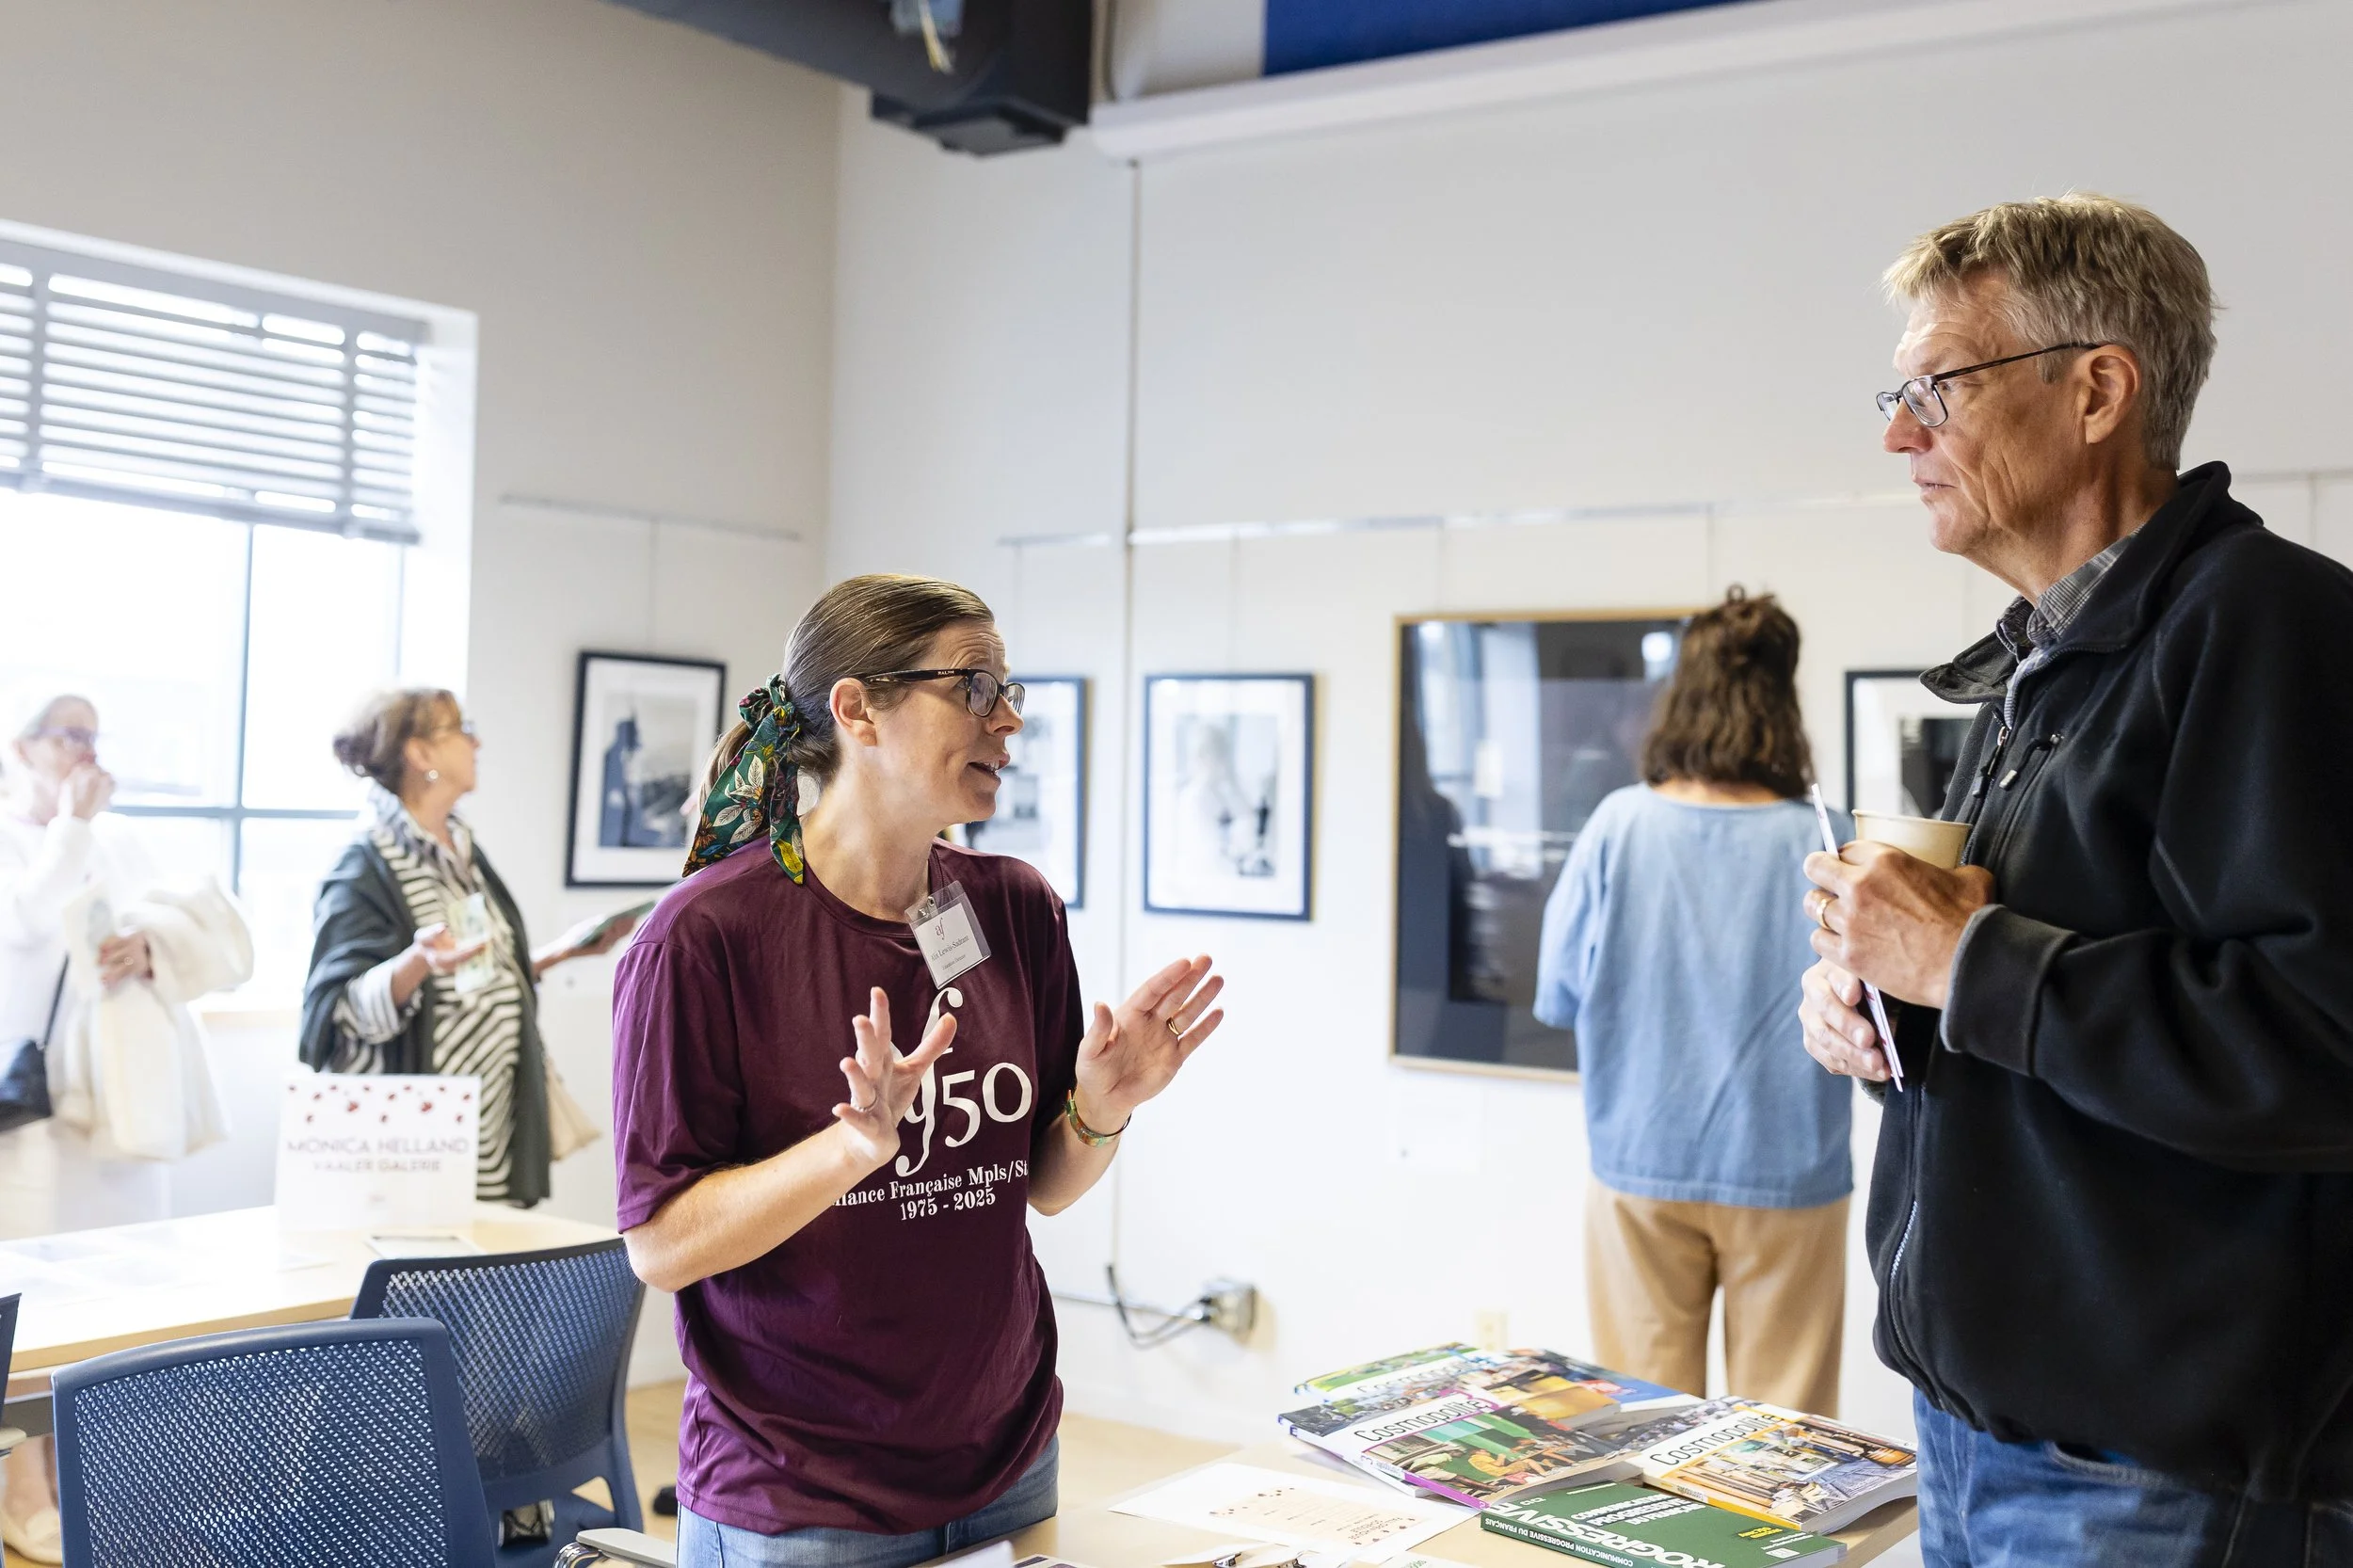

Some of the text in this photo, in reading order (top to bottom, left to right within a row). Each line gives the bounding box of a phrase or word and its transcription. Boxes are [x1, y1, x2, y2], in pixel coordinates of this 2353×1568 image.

[889, 1174, 962, 1199] Française
[900, 1197, 937, 1221] 1975
[952, 1188, 996, 1211] 2025
[1353, 1400, 1487, 1443] Cosmopolite
[1650, 1414, 1785, 1466] Cosmopolite
[1485, 1517, 1634, 1567] COMMUNICATION PROGRESSIVE DU FRANÇAIS
